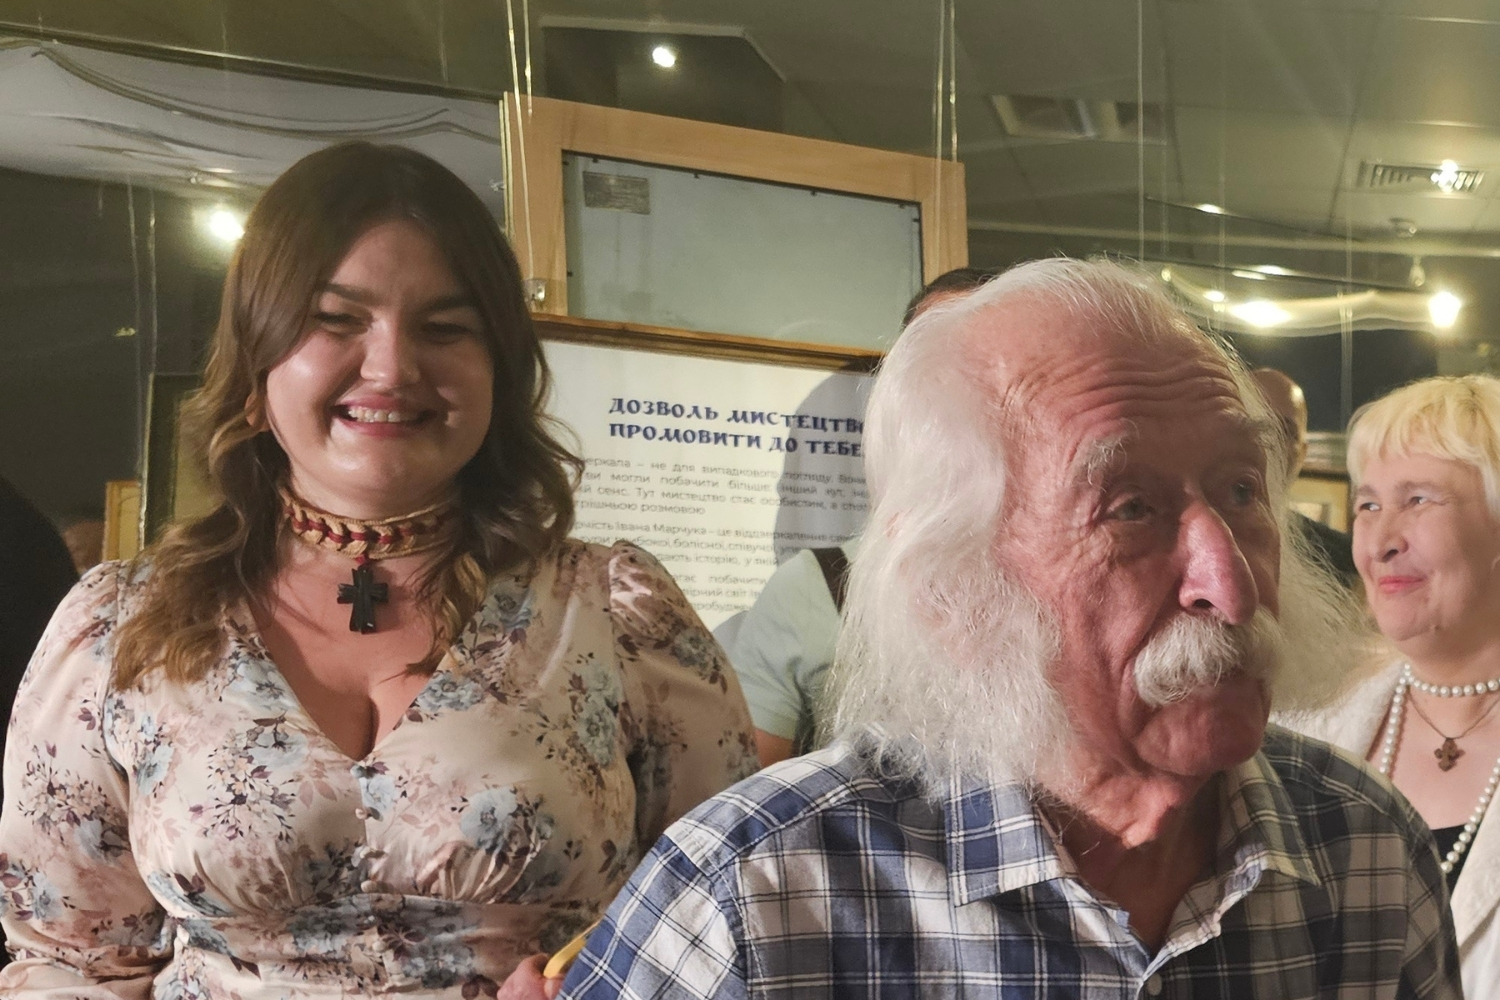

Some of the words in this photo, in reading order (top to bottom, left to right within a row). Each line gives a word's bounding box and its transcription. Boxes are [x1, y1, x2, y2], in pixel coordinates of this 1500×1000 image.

[608, 398, 718, 420] ДОЗВОЛЬ
[609, 423, 761, 449] ПРОМОВИТИ
[769, 436, 798, 453] ДО
